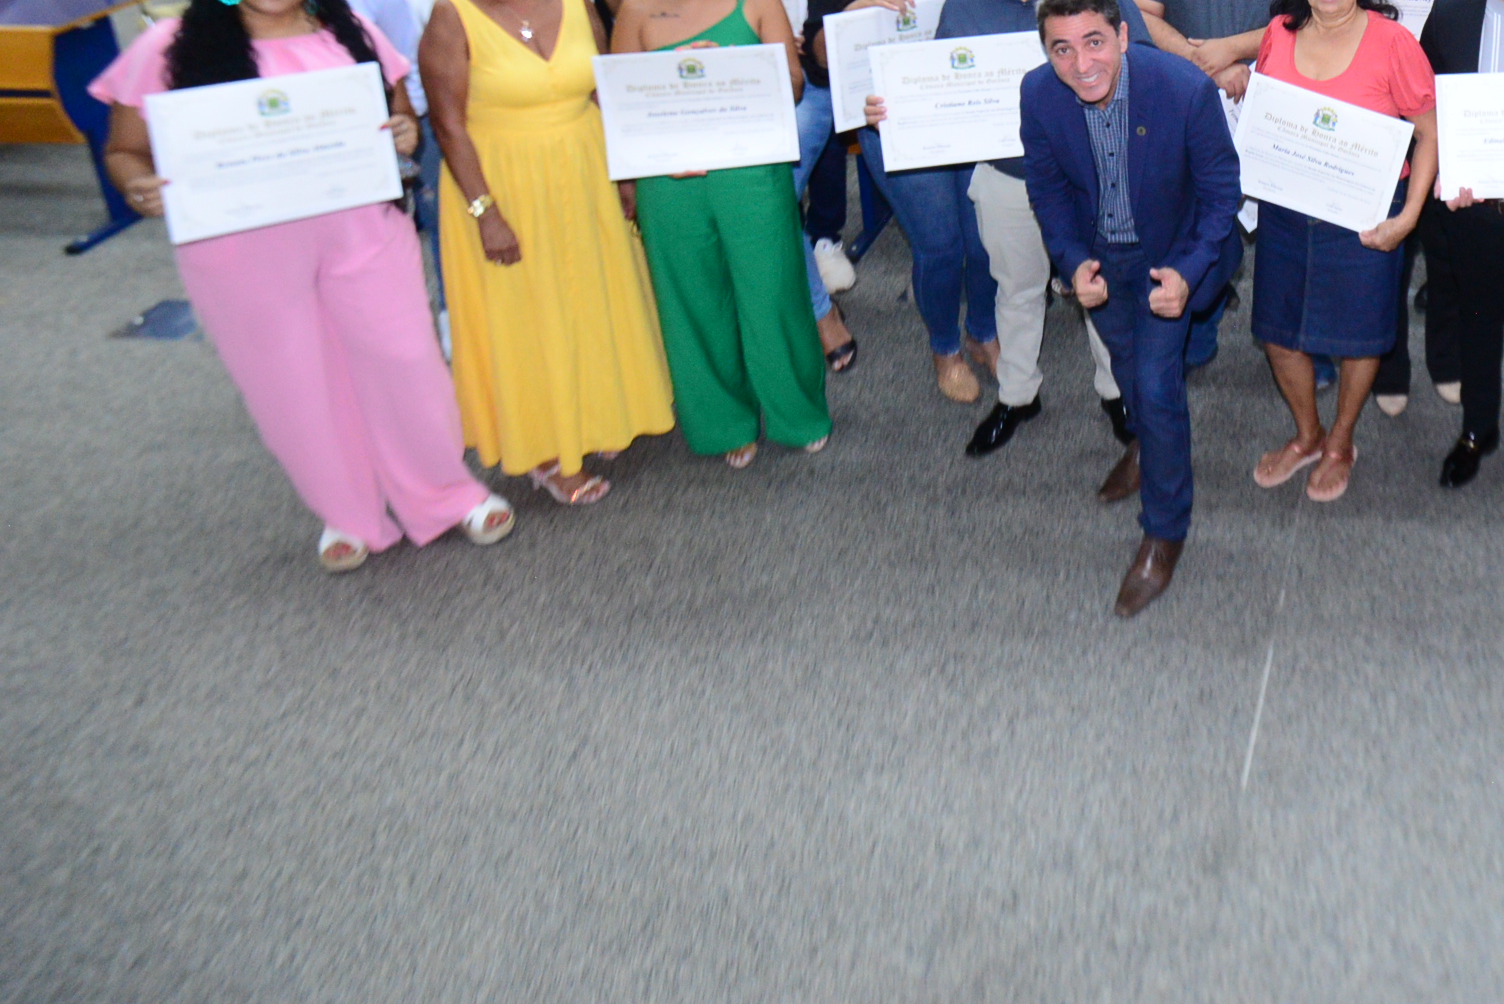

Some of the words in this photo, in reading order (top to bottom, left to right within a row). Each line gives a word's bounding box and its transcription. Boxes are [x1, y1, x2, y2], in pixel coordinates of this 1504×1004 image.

[902, 76, 939, 84] Diploma
[1463, 109, 1499, 118] Diploma
[1264, 112, 1298, 130] Diploma
[1300, 124, 1309, 134] de
[1311, 127, 1337, 143] Honra
[1339, 139, 1348, 147] ao
[1351, 142, 1379, 157] Mérito
[1273, 143, 1290, 155] Maria
[1292, 150, 1306, 160] José
[1307, 155, 1322, 165] Silva
[1323, 161, 1355, 176] Rodrigues
